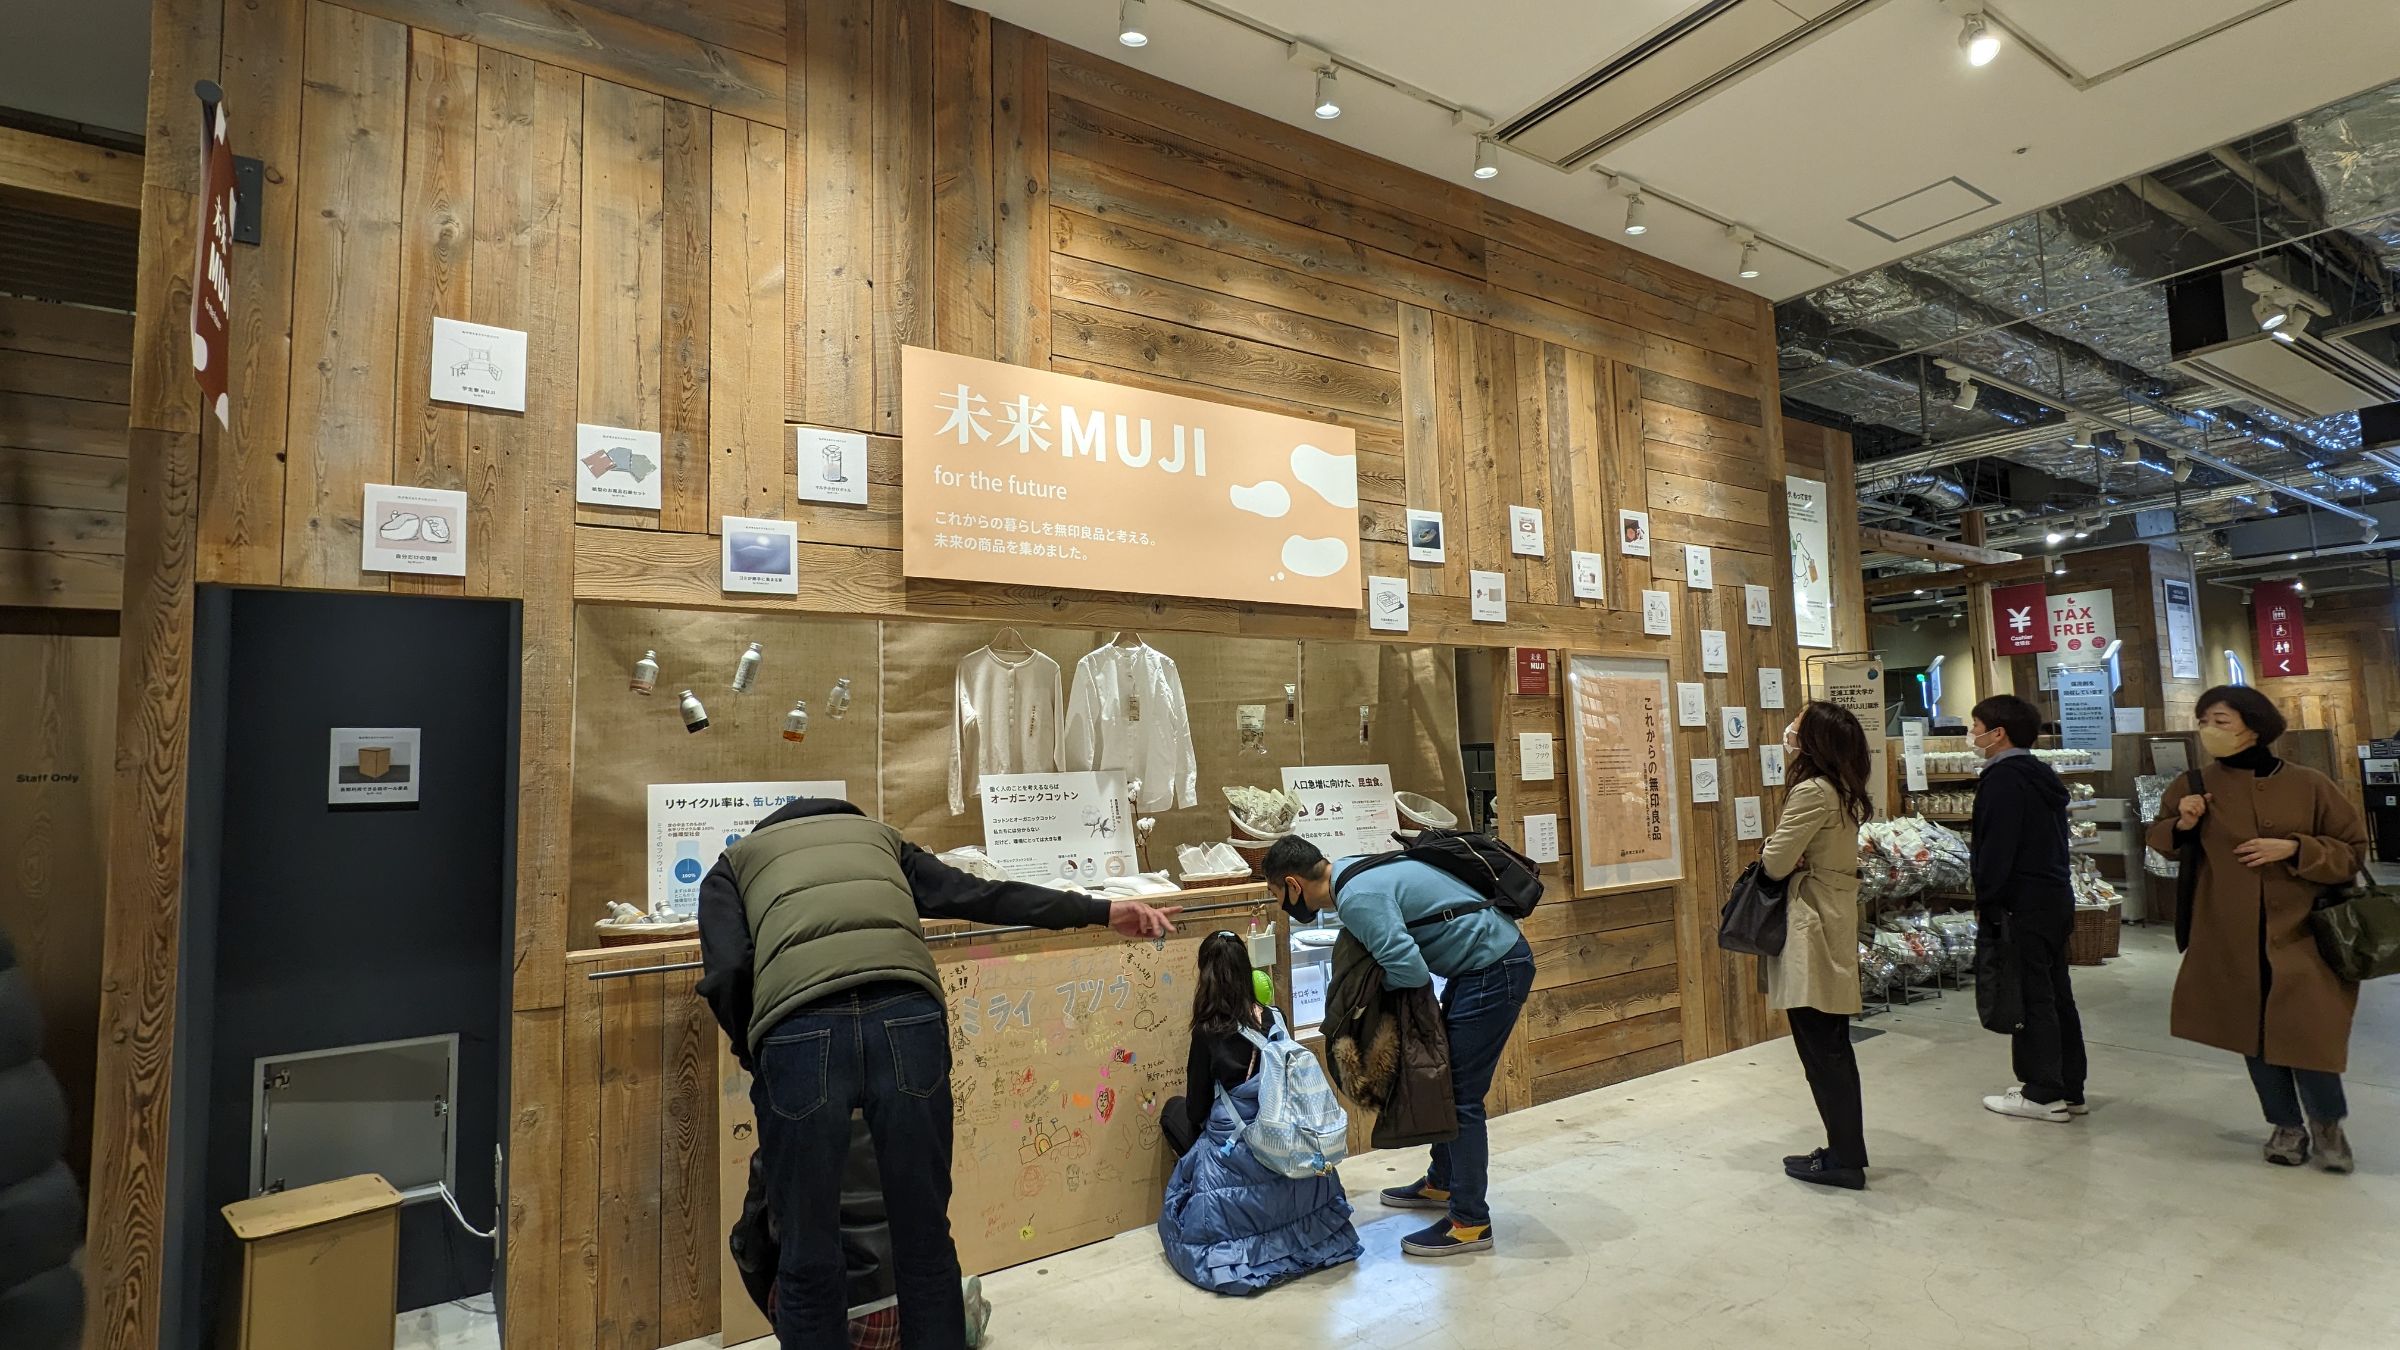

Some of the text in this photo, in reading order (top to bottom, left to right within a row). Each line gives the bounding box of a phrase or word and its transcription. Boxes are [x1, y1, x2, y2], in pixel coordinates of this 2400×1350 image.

[207, 240, 231, 321] MUJI
[934, 464, 1068, 501] for the future
[935, 511, 1156, 546] これからの暮らしを無印良品と考える。
[934, 533, 1088, 561] 未来の商品を集めました。
[2053, 606, 2093, 622] TAX
[2053, 621, 2096, 637] FREE
[1530, 662, 1545, 670] MUJI
[1644, 697, 1662, 841] これからの無印良品
[16, 773, 79, 784] Staff Only
[1292, 776, 1384, 790] 人口急増に向けた、昆虫食。
[665, 795, 817, 810] リサイクル率は、缶しか勝
[991, 791, 1079, 804] オーガニックコットン
[962, 975, 1133, 1037] ミライ フツウ
